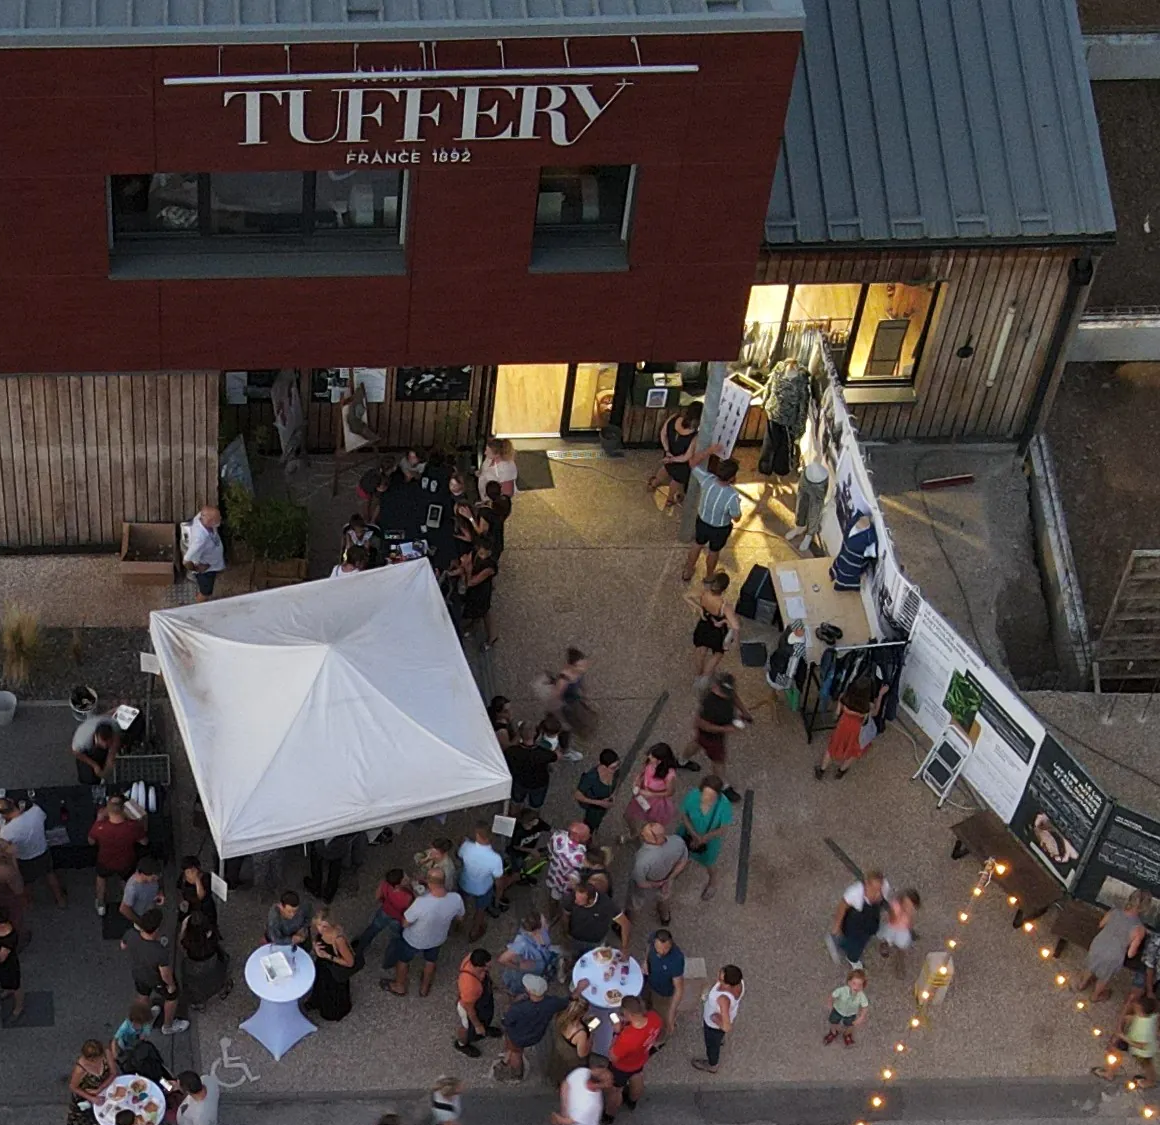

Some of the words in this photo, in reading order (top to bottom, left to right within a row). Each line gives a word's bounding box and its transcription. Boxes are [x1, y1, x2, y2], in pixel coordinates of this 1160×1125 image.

[223, 79, 633, 146] TUFFERY
[346, 151, 421, 164] FRANCE
[432, 150, 472, 163] 1892
